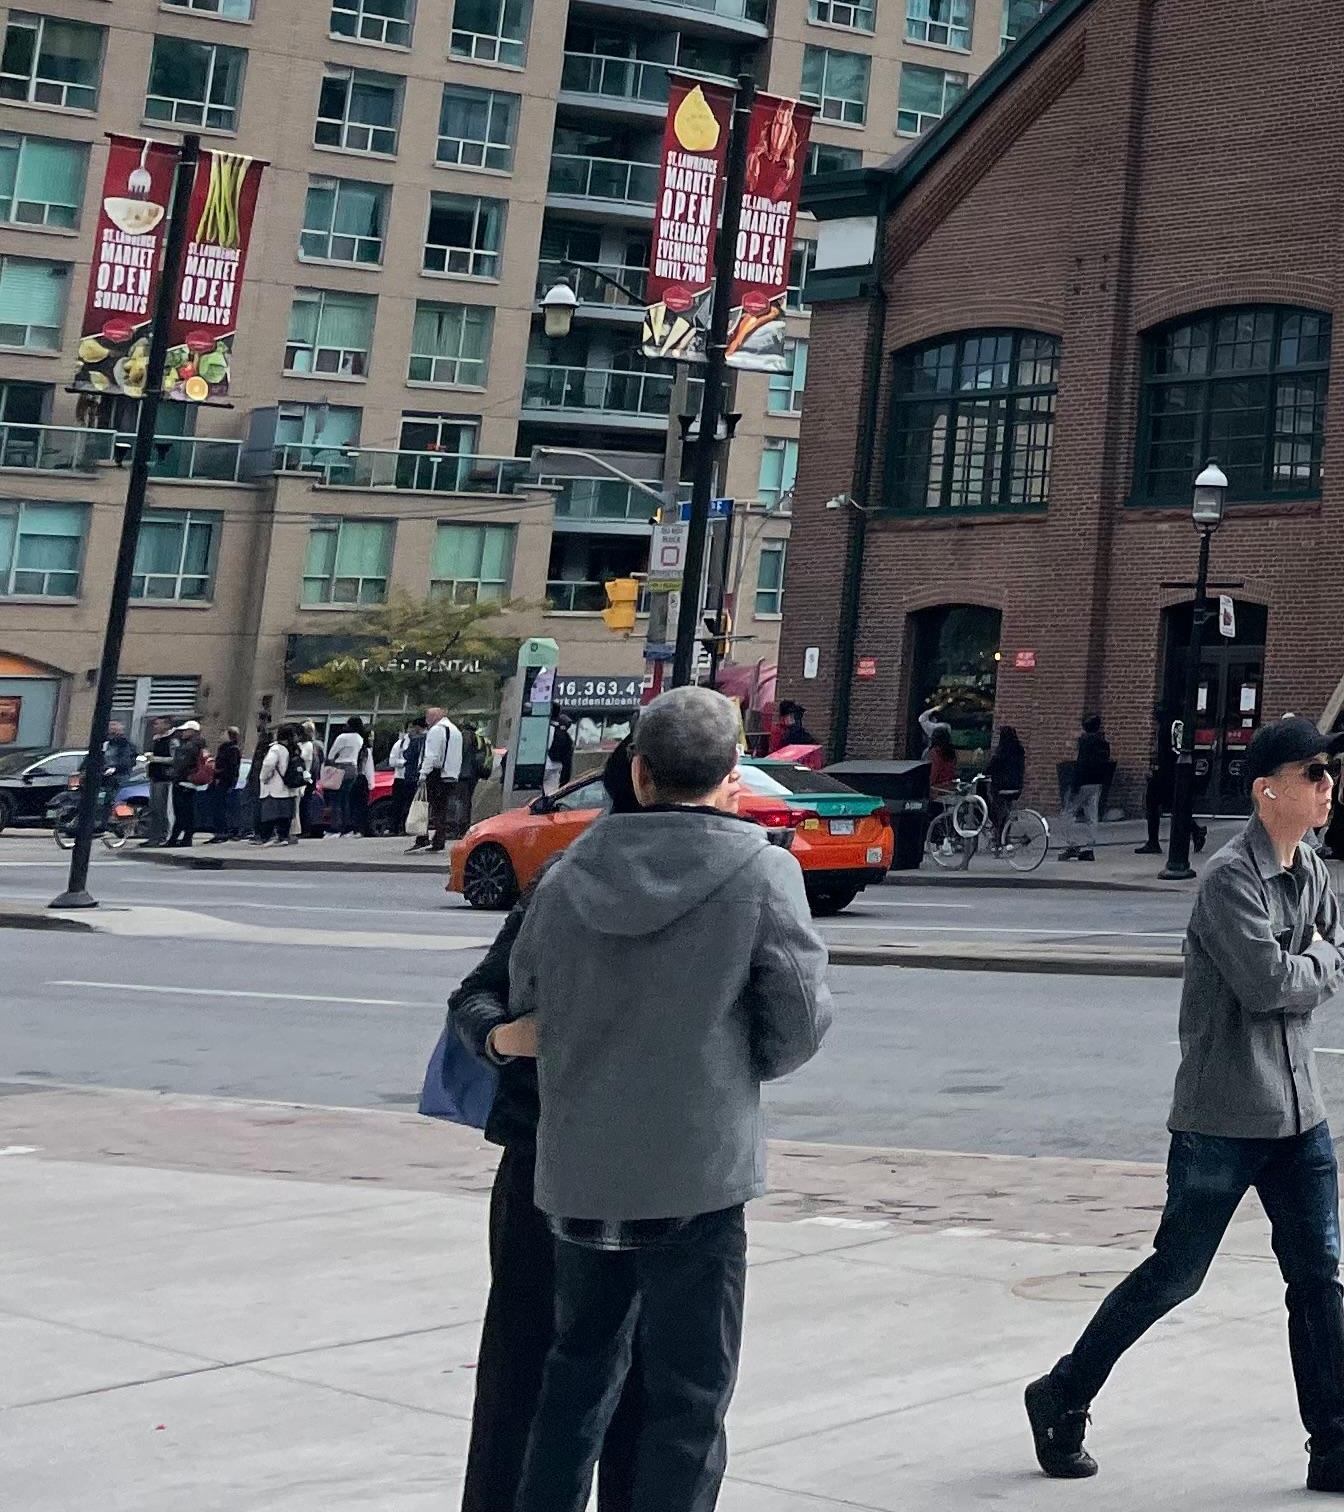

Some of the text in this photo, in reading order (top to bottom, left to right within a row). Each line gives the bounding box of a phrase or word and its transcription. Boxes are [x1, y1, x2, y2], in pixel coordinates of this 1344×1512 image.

[665, 165, 717, 196] MARKET
[662, 188, 713, 226] OPEN
[660, 218, 710, 246] WEEKDAY
[739, 209, 790, 237] MARKET
[100, 242, 155, 268] MARKET
[657, 238, 708, 265] EVENINGS
[736, 231, 786, 266] OPEN
[97, 263, 152, 296] OPEN
[185, 255, 239, 281] MARKET
[655, 259, 681, 280] UNTIL
[733, 260, 783, 286] SUNDAYS
[94, 290, 148, 315] SUNDAYS
[181, 276, 235, 308] OPEN
[178, 303, 231, 326] SUNDAYS
